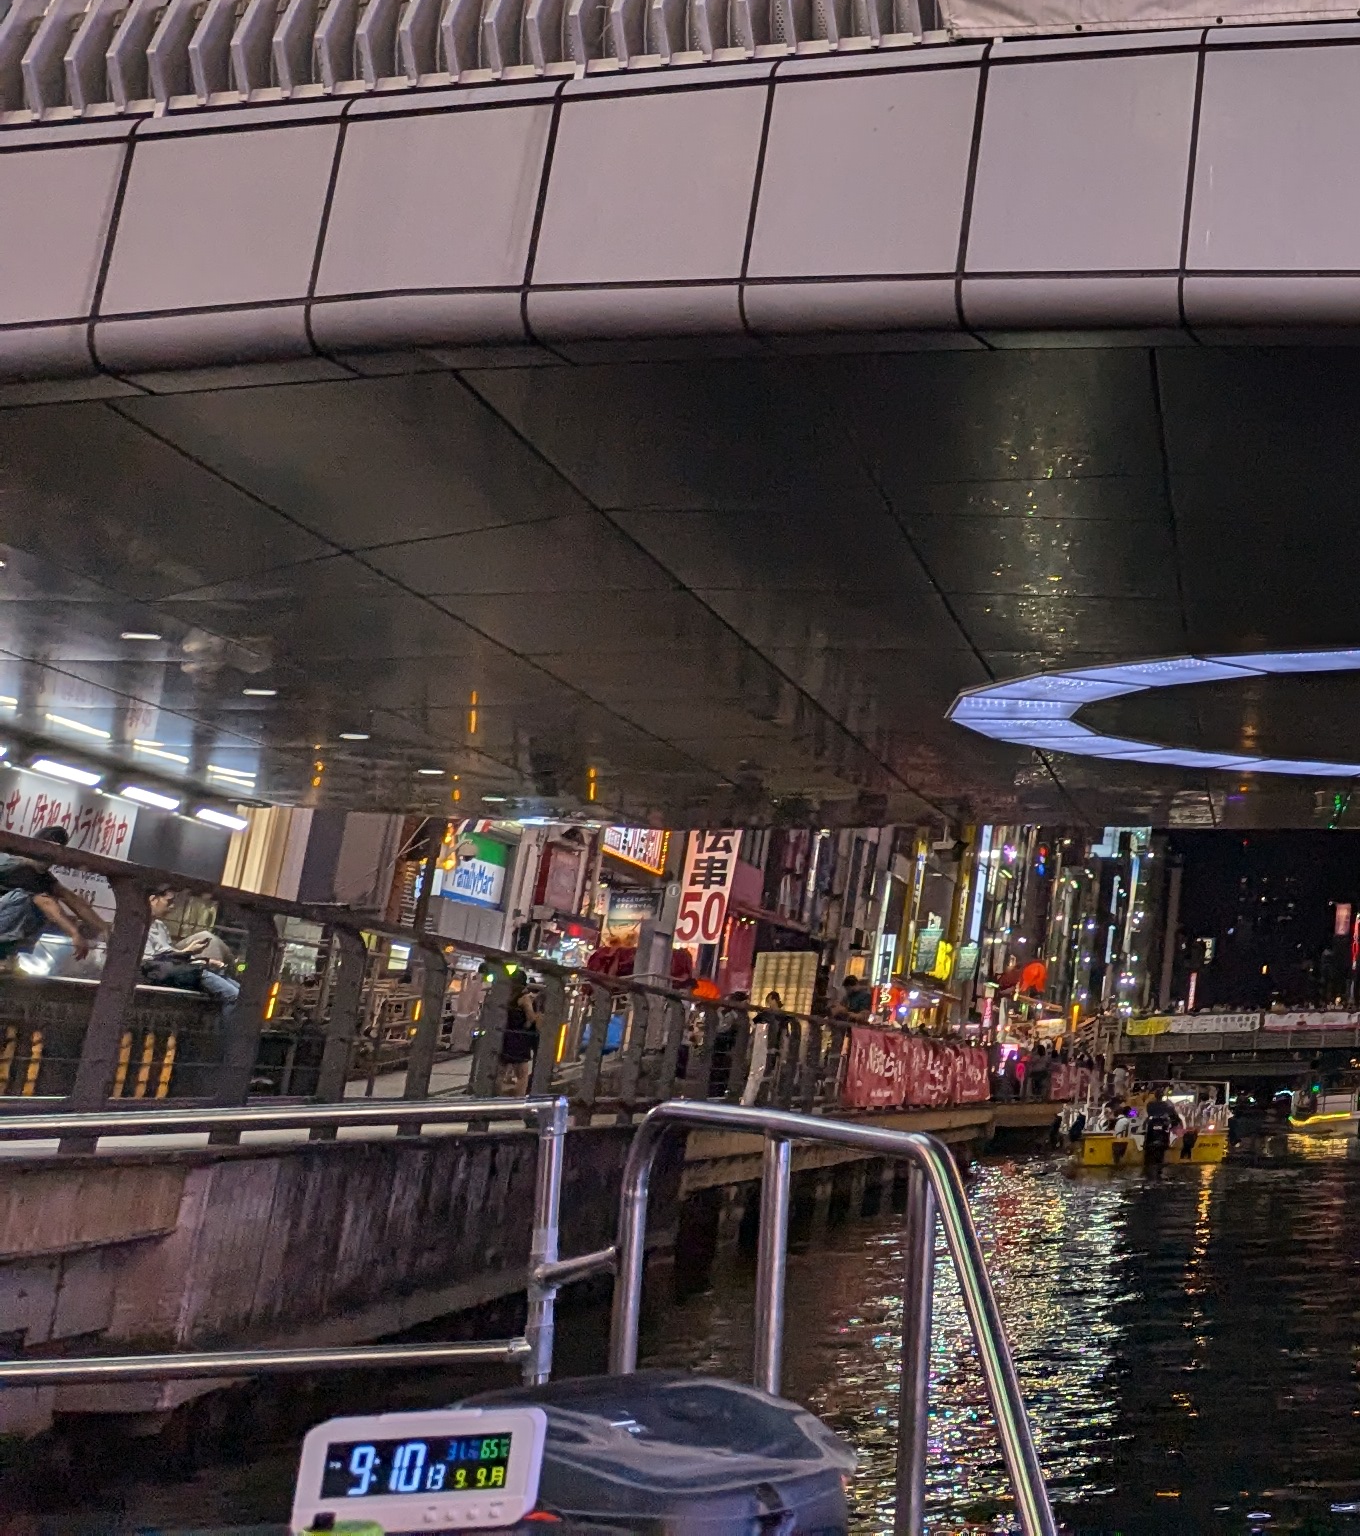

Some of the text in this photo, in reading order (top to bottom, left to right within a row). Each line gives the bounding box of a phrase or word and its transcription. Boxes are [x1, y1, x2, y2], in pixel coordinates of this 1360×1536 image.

[676, 891, 727, 942] 50
[347, 1441, 446, 1496] 9:10 13
[480, 1438, 499, 1459] 65
